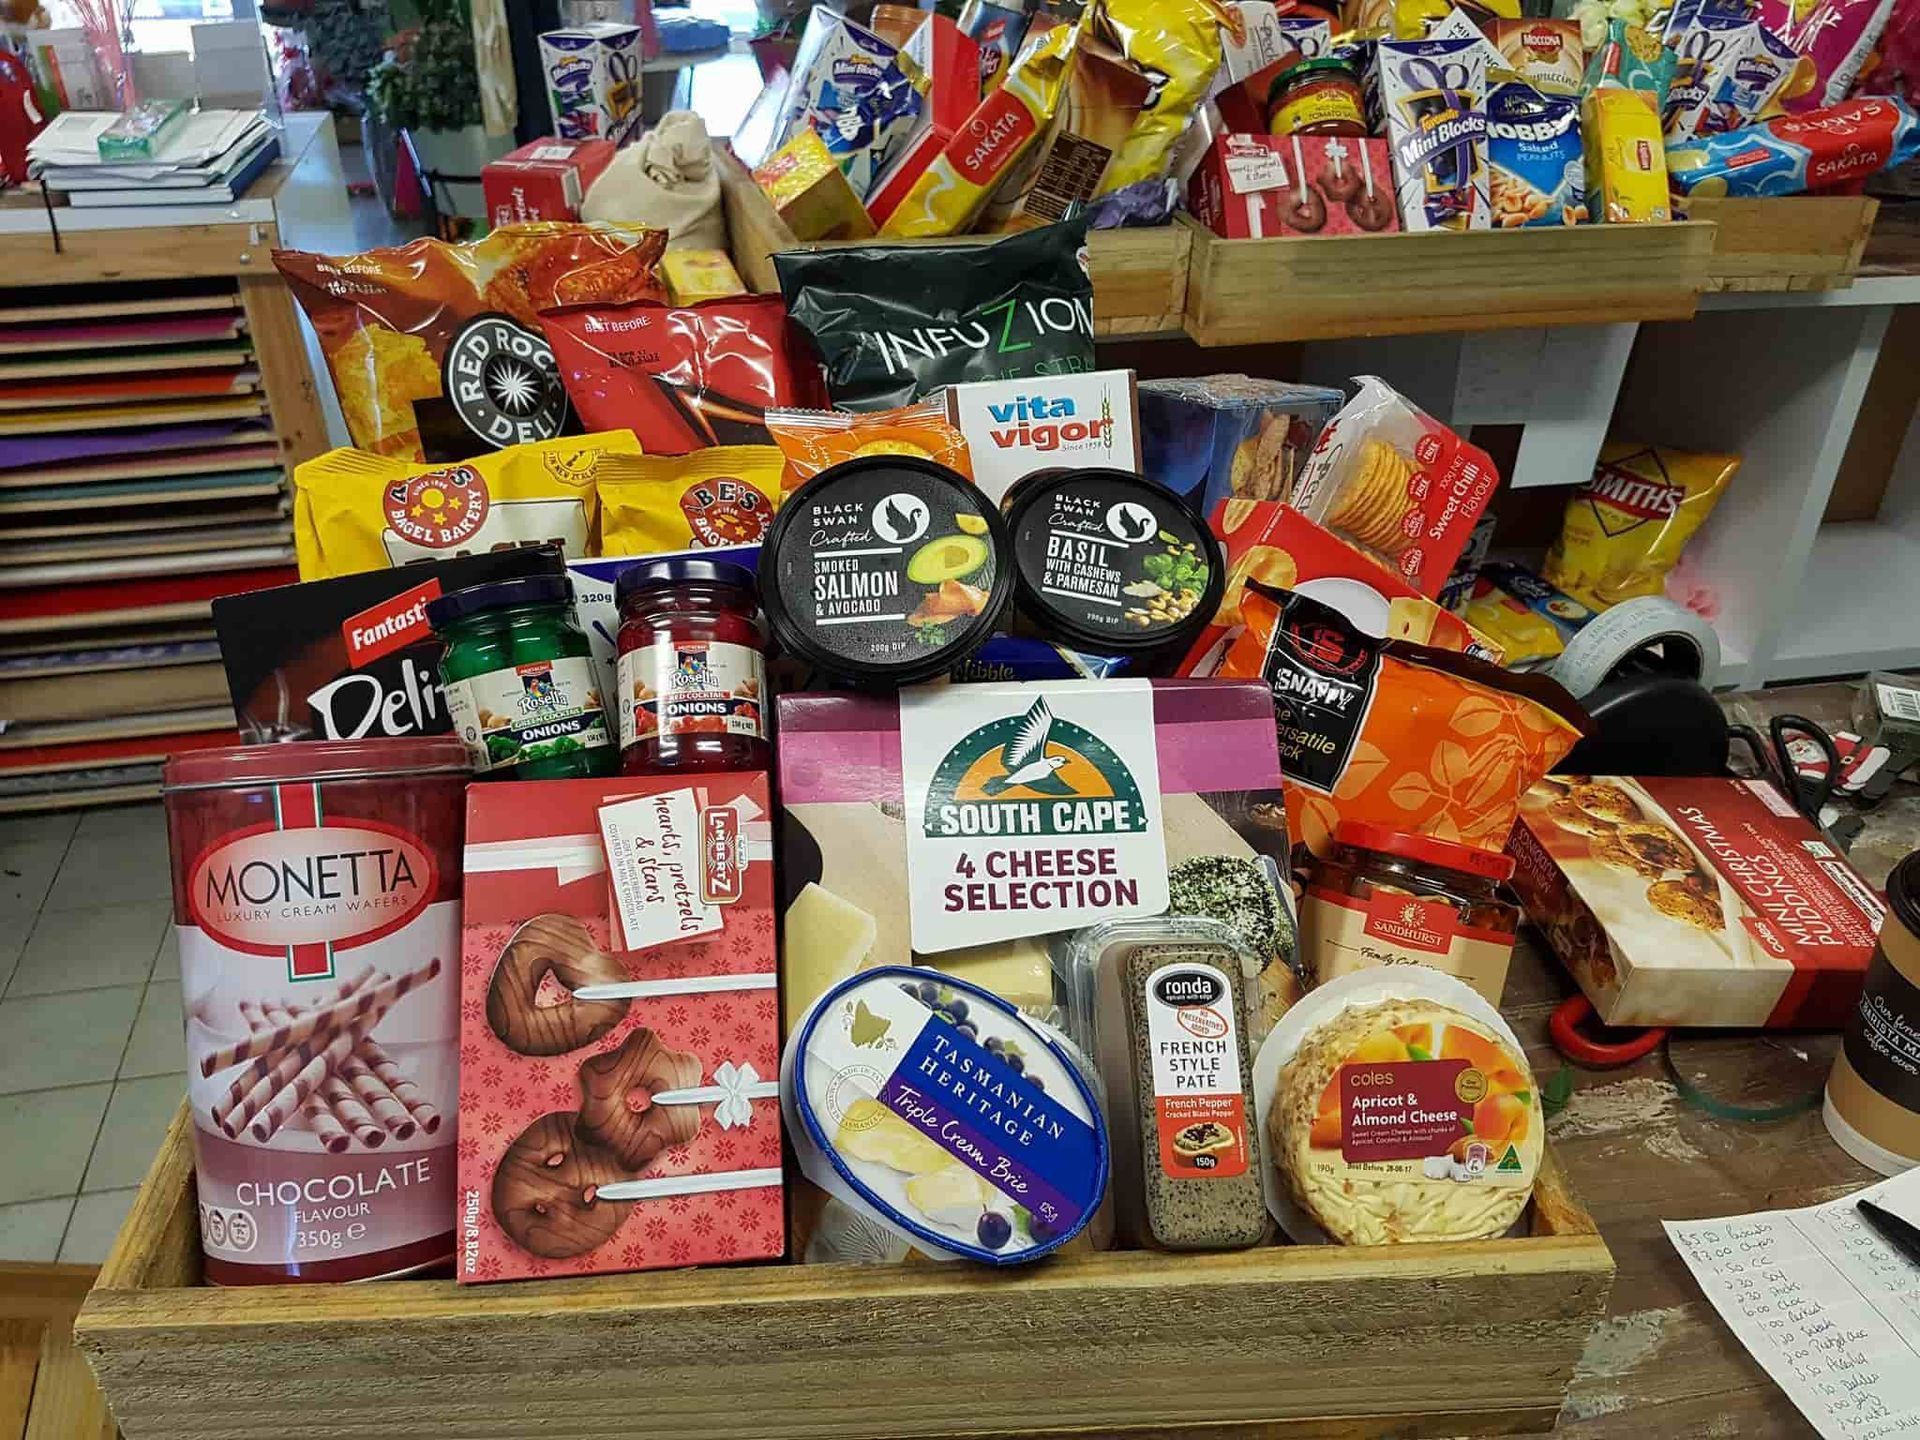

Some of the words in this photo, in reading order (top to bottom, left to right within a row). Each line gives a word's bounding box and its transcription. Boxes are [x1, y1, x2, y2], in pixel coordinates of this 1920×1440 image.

[964, 109, 1021, 172] SAKATA
[1400, 130, 1438, 168] Mini
[1438, 116, 1486, 143] Blocks
[1815, 151, 1878, 177] SAKATA
[611, 315, 651, 332] BEFORE
[873, 296, 1095, 376] INFUZION
[456, 334, 491, 403] RED
[494, 326, 563, 397] ROCK
[986, 395, 1077, 423] vita
[487, 410, 558, 446] DELI
[989, 419, 1114, 452] vigor
[1055, 493, 1102, 509] BLACK
[1428, 488, 1462, 541] Sweet
[1453, 461, 1481, 498] Chilli
[1460, 471, 1493, 518] Flavour
[390, 509, 435, 543] BAGEL
[439, 488, 483, 543] BAKERY
[812, 502, 865, 517] BLACK
[812, 514, 858, 528] SWAN
[1047, 511, 1107, 534] Crafted
[1053, 502, 1096, 518] SWAN
[809, 529, 874, 549] Crafted
[1046, 534, 1110, 569] BASIL
[814, 558, 860, 575] SMOKED
[1045, 557, 1072, 574] WITH
[1072, 563, 1122, 584] CASHEWS
[814, 570, 900, 601] SALMON
[1042, 570, 1053, 586] &
[1055, 572, 1120, 600] PARMESAN
[581, 593, 613, 605] 320g
[815, 602, 825, 617] &
[828, 598, 882, 617] AVOCADO
[668, 668, 720, 691] Rosella
[516, 688, 569, 715] Rosella
[666, 701, 727, 715] ONIONS
[686, 690, 725, 700] COCKTAIL
[516, 715, 543, 729] GREEN
[542, 706, 581, 721] COCKTAIL
[1274, 704, 1292, 722] he
[521, 720, 581, 741] ONIONS
[1275, 719, 1338, 756] ersatile
[652, 796, 684, 857] hearts,
[939, 802, 1041, 835] SOUTH
[1052, 800, 1132, 832] CAPE
[635, 836, 655, 850] &
[708, 811, 733, 896] LAMBERTZ
[1676, 805, 1774, 898] CHRISTMAS
[955, 852, 976, 879] 4
[985, 848, 1118, 879] CHEESE
[205, 847, 419, 909] MONETTA
[637, 855, 666, 904] stars
[657, 861, 704, 932] pretzels
[944, 879, 1139, 912] SELECTION
[1746, 854, 1845, 946] PUDDINGS
[216, 907, 272, 924] LUXURY
[280, 903, 338, 920] CREAM
[346, 895, 410, 913] WAFERS
[1373, 920, 1445, 946] SANDHURST
[1754, 921, 1785, 954] coles
[1762, 902, 1820, 946] MINI
[1165, 976, 1212, 995] ronda
[1874, 995, 1894, 1022] Our
[1863, 1001, 1900, 1046] BARISTA
[1160, 1040, 1227, 1055] FRENCH
[1863, 1028, 1890, 1057] coffee
[1169, 1057, 1221, 1072] STYLE
[1350, 1069, 1395, 1087] coles
[933, 1034, 1065, 1140] TASMANIAN
[918, 1055, 1033, 1147] HERITAGE
[1165, 1098, 1198, 1109] French
[1199, 1097, 1233, 1110] Pepper
[1192, 1109, 1211, 1118] Black
[1211, 1109, 1235, 1119] Pepper
[1351, 1094, 1404, 1112] Apricot
[1406, 1092, 1418, 1106] &
[1351, 1109, 1406, 1127] Almond
[1409, 1109, 1458, 1124] Cheese
[894, 1085, 939, 1129] Triple
[941, 1115, 989, 1167] Cream
[990, 1156, 1029, 1194] Brie
[1194, 1156, 1216, 1169] 150g
[1316, 1163, 1335, 1175] 190g
[235, 1156, 432, 1207] CHOCOLATE
[293, 1201, 371, 1224] FLAVOUR
[296, 1228, 343, 1250] 350g
